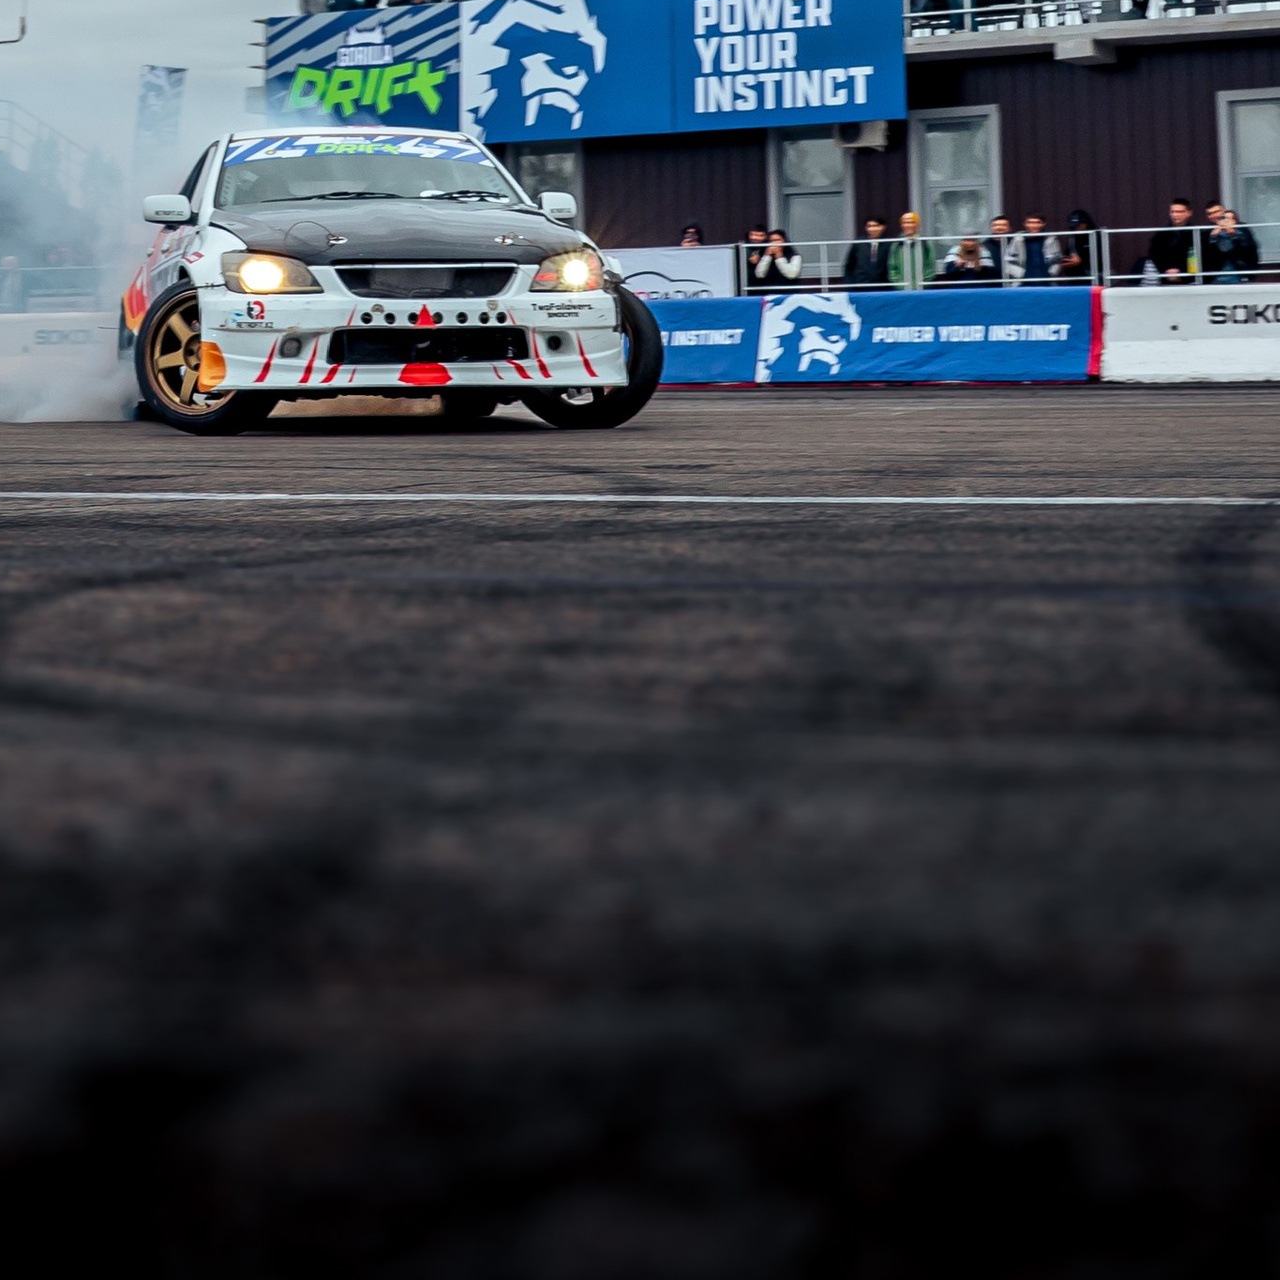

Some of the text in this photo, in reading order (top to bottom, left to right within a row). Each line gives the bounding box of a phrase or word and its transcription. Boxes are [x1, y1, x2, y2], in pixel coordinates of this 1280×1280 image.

[693, 32, 797, 73] YOUR
[694, 66, 874, 113] INSTINCT
[1208, 304, 1280, 324] SOK
[670, 329, 745, 346] INSTINCT
[872, 324, 1071, 343] POWER YOUR INSTINCT
